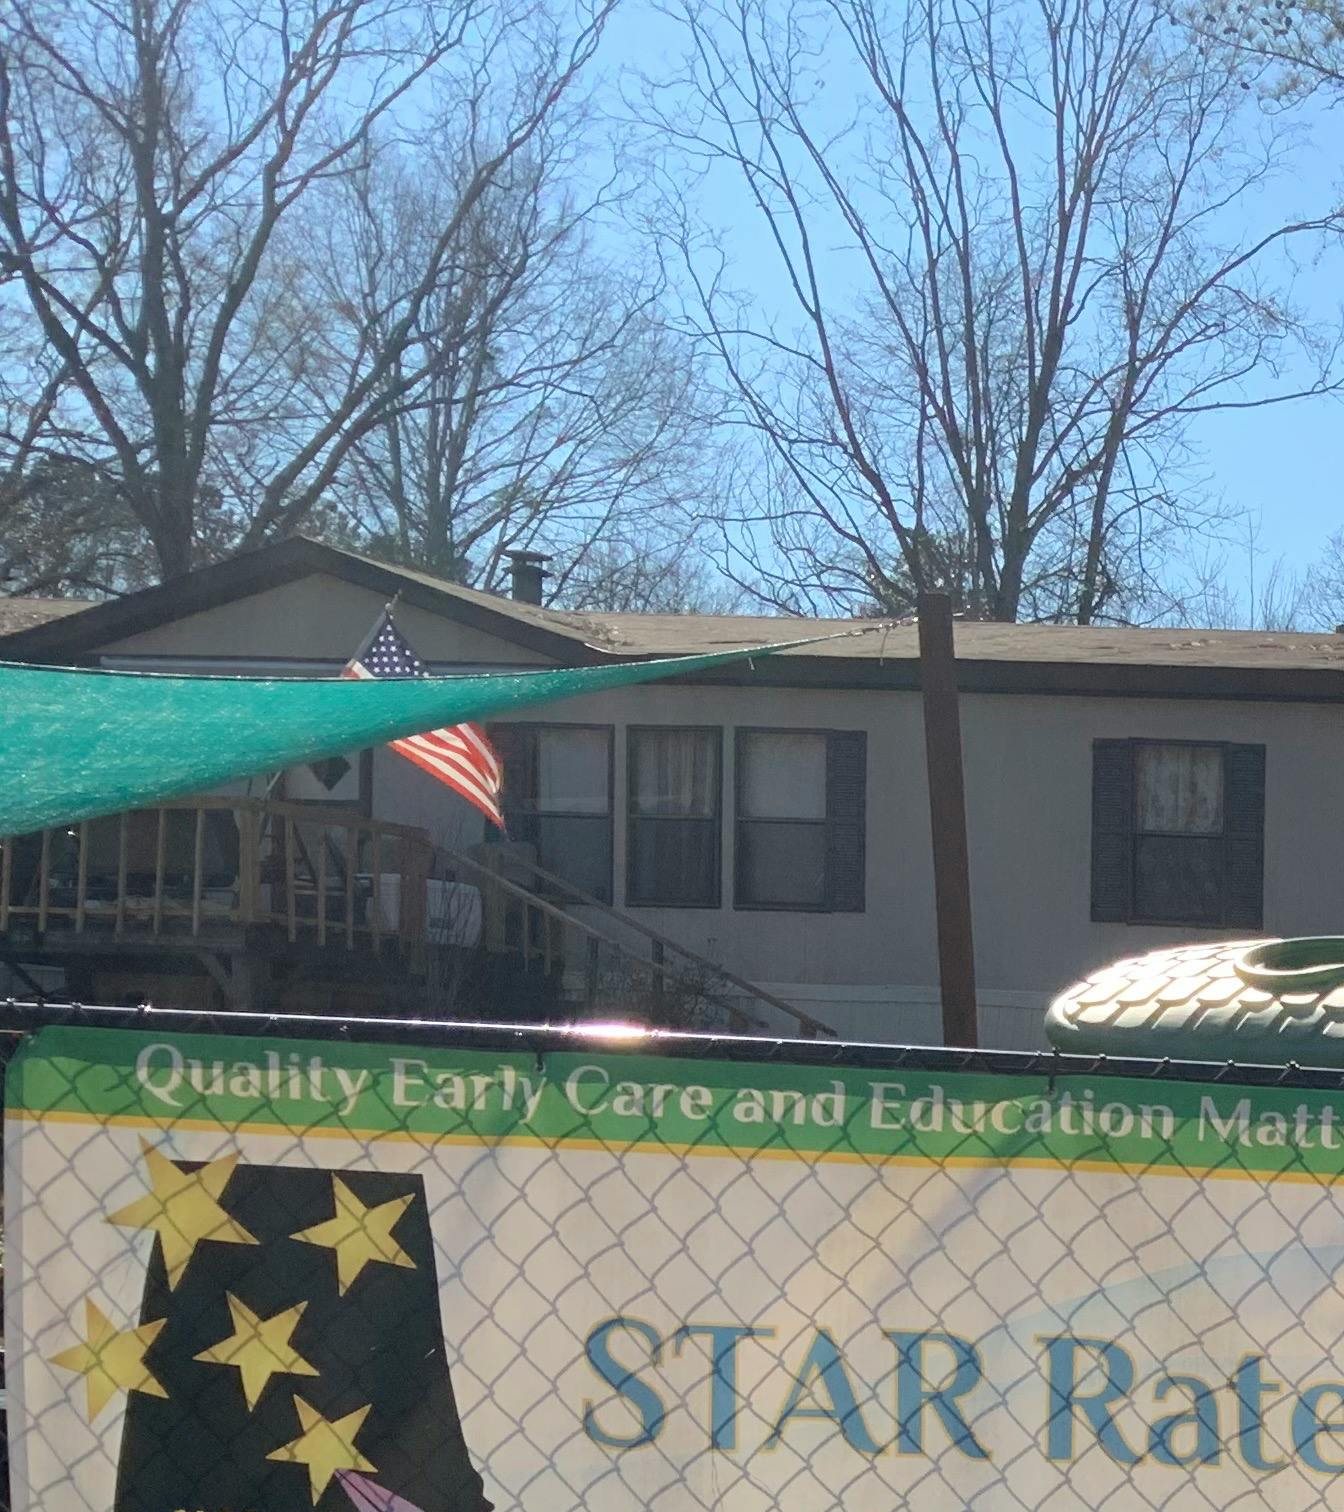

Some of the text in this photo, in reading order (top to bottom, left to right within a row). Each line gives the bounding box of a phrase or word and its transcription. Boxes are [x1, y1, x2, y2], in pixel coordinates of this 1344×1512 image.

[136, 1043, 369, 1106] Quality
[391, 1057, 543, 1122] Early
[565, 1067, 713, 1120] Care
[733, 1081, 846, 1130] and
[869, 1082, 1175, 1141] Education
[581, 1315, 991, 1463] STAR
